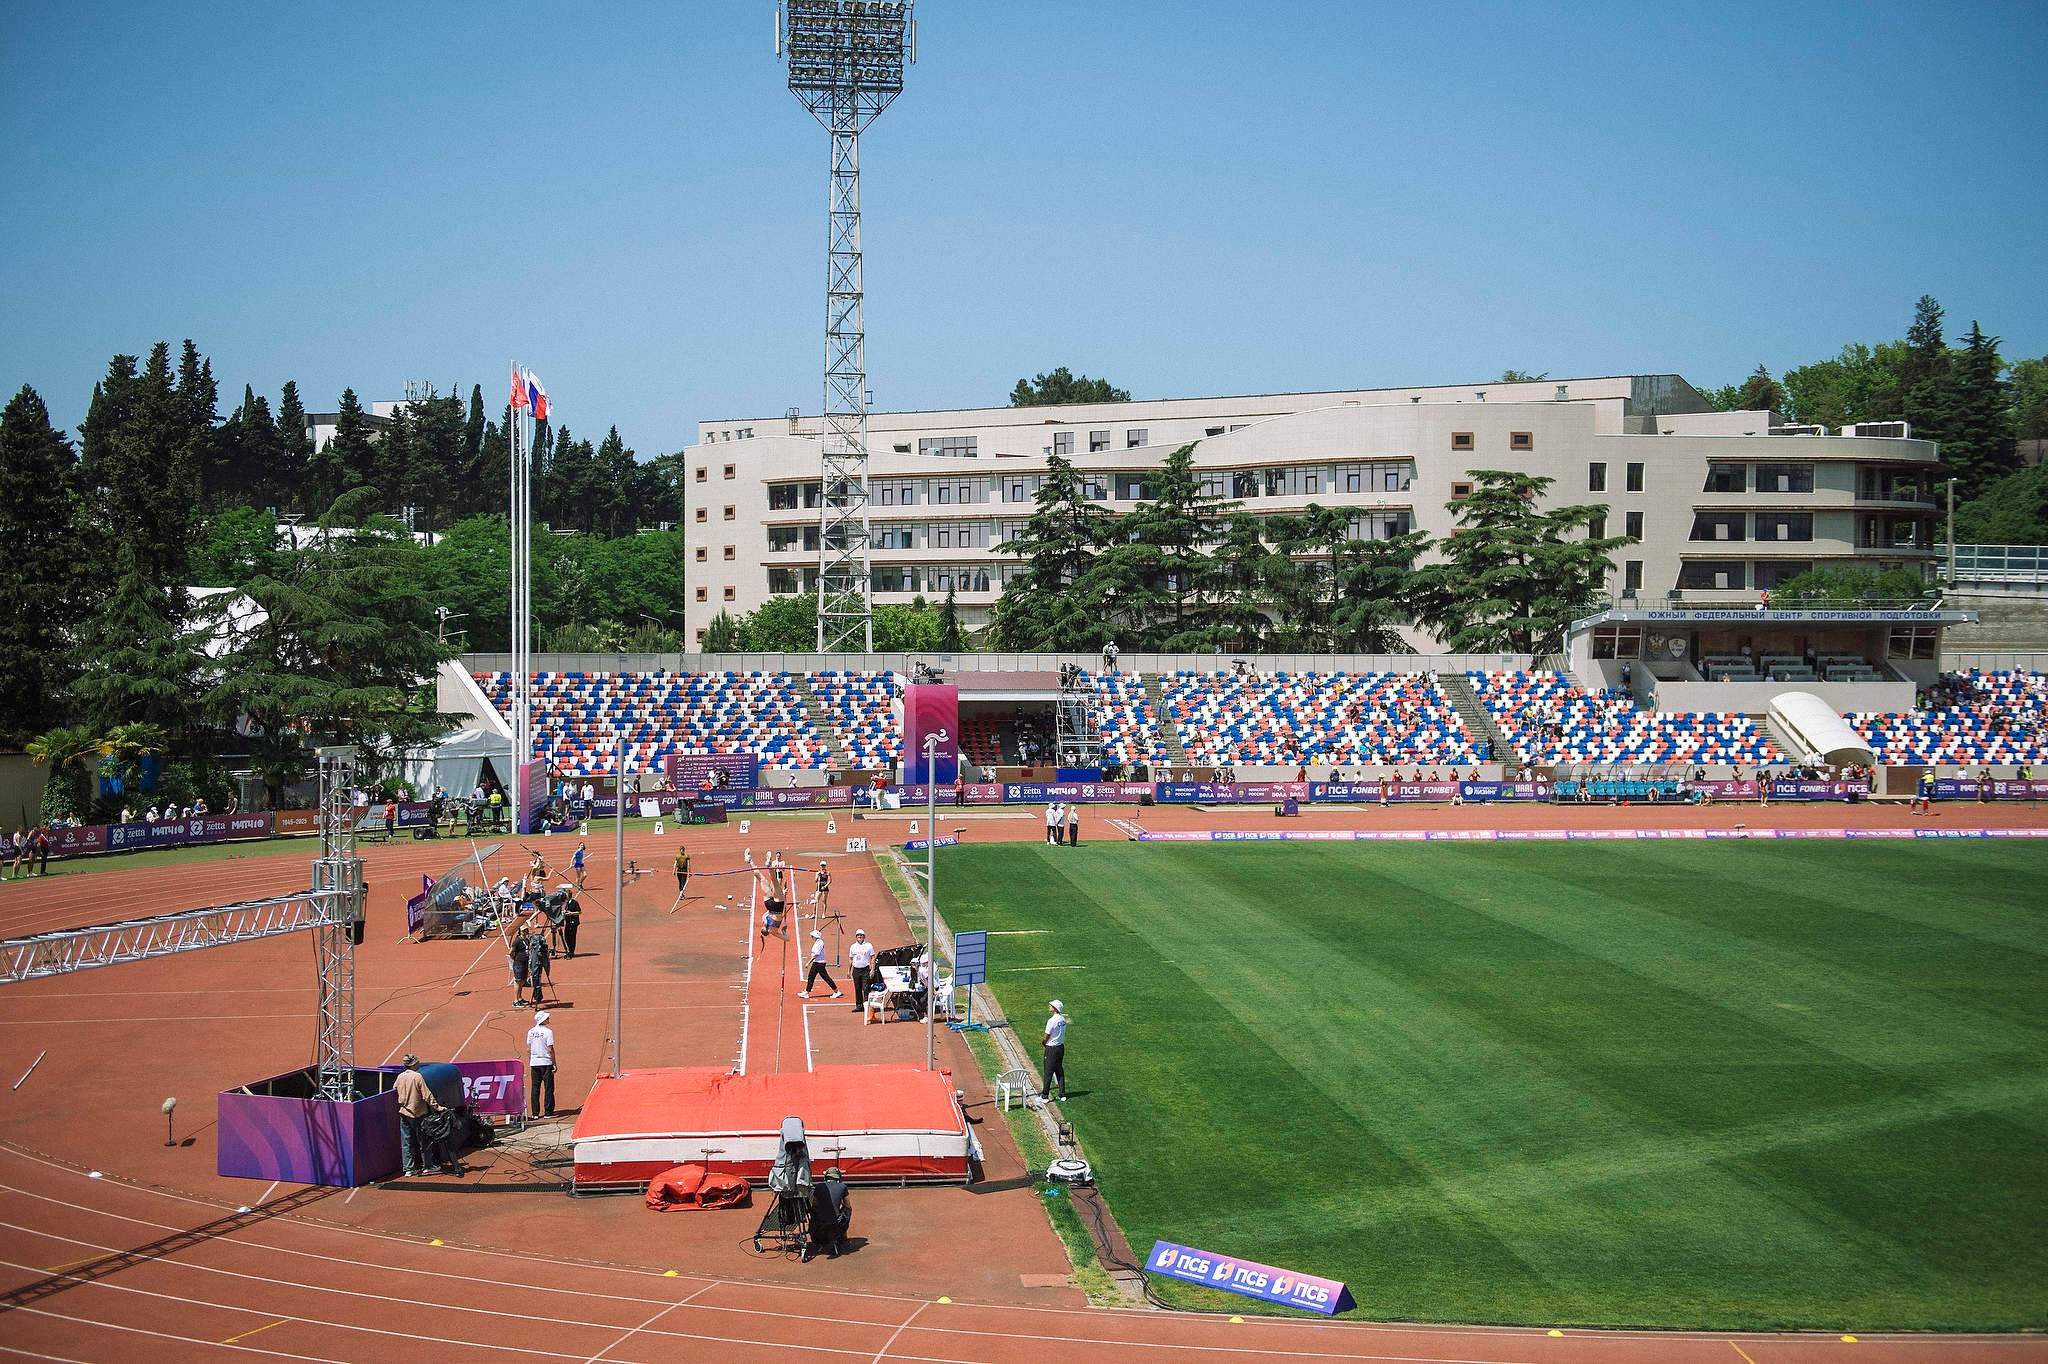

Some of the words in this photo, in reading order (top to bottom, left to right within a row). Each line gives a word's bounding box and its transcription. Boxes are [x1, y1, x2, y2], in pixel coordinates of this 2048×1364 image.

[1648, 611, 1686, 619] ЮЖНЫЙ
[1694, 611, 1765, 620] ФЕДЕРАЛЬНЫЙ
[1773, 611, 1803, 620] ЦЕНТР
[1810, 611, 1872, 619] СПОРТИВНОЙ
[1880, 611, 1941, 620] ПОДГОТОВКИ
[1328, 786, 1348, 794] ПСБ
[1400, 786, 1420, 794] ПСБ
[1423, 786, 1455, 794] FONBET
[1515, 784, 1534, 792] URAL
[1777, 784, 1797, 792] ПСБ
[1848, 784, 1868, 792] ПСБ
[755, 792, 774, 800] URAL
[829, 789, 847, 798] URAL
[207, 822, 226, 830] zetta
[127, 830, 146, 838] zetta
[462, 1075, 515, 1100] BET
[1176, 1255, 1211, 1274] ПСБ
[1235, 1268, 1269, 1287] ПСБ
[1294, 1282, 1329, 1303] ПСБ
